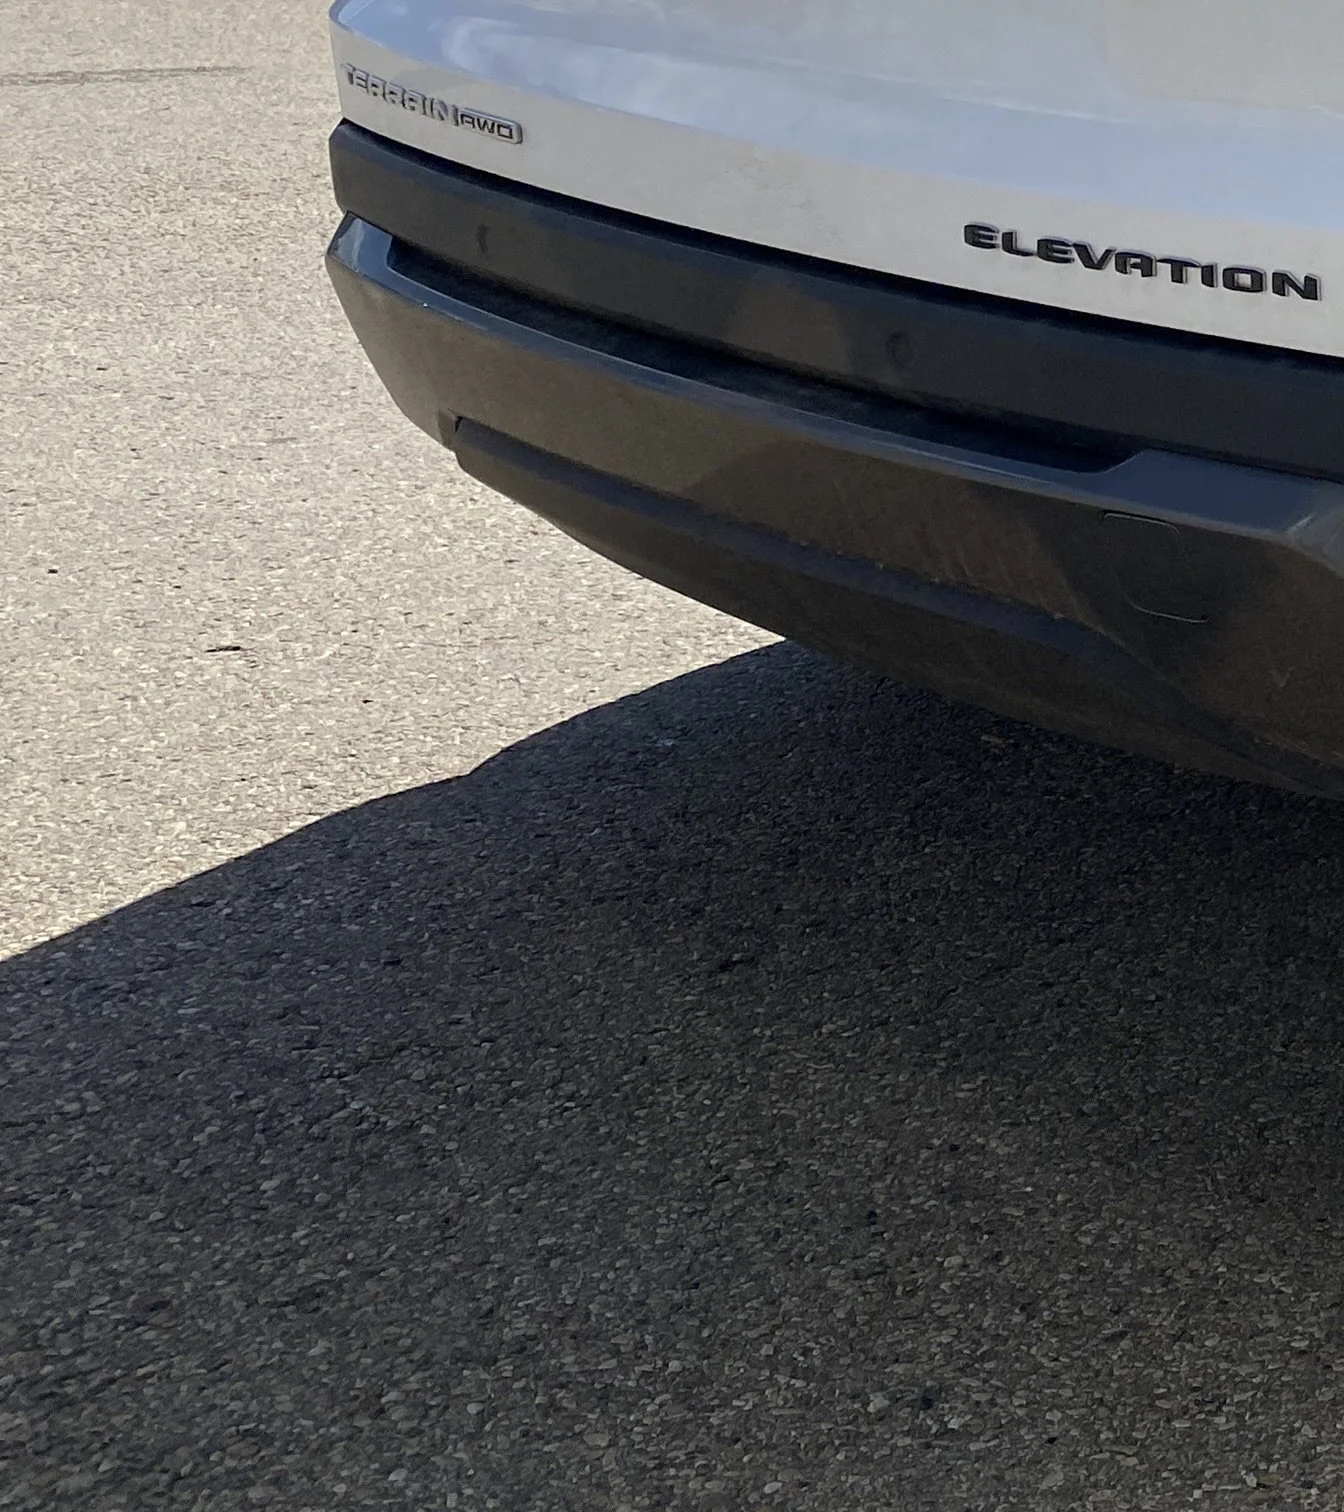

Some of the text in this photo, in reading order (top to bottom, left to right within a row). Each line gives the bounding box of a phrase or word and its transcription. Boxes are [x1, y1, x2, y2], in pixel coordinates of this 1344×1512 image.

[341, 62, 514, 140] TERRAIN AWD
[962, 220, 1322, 302] ELEVATION
